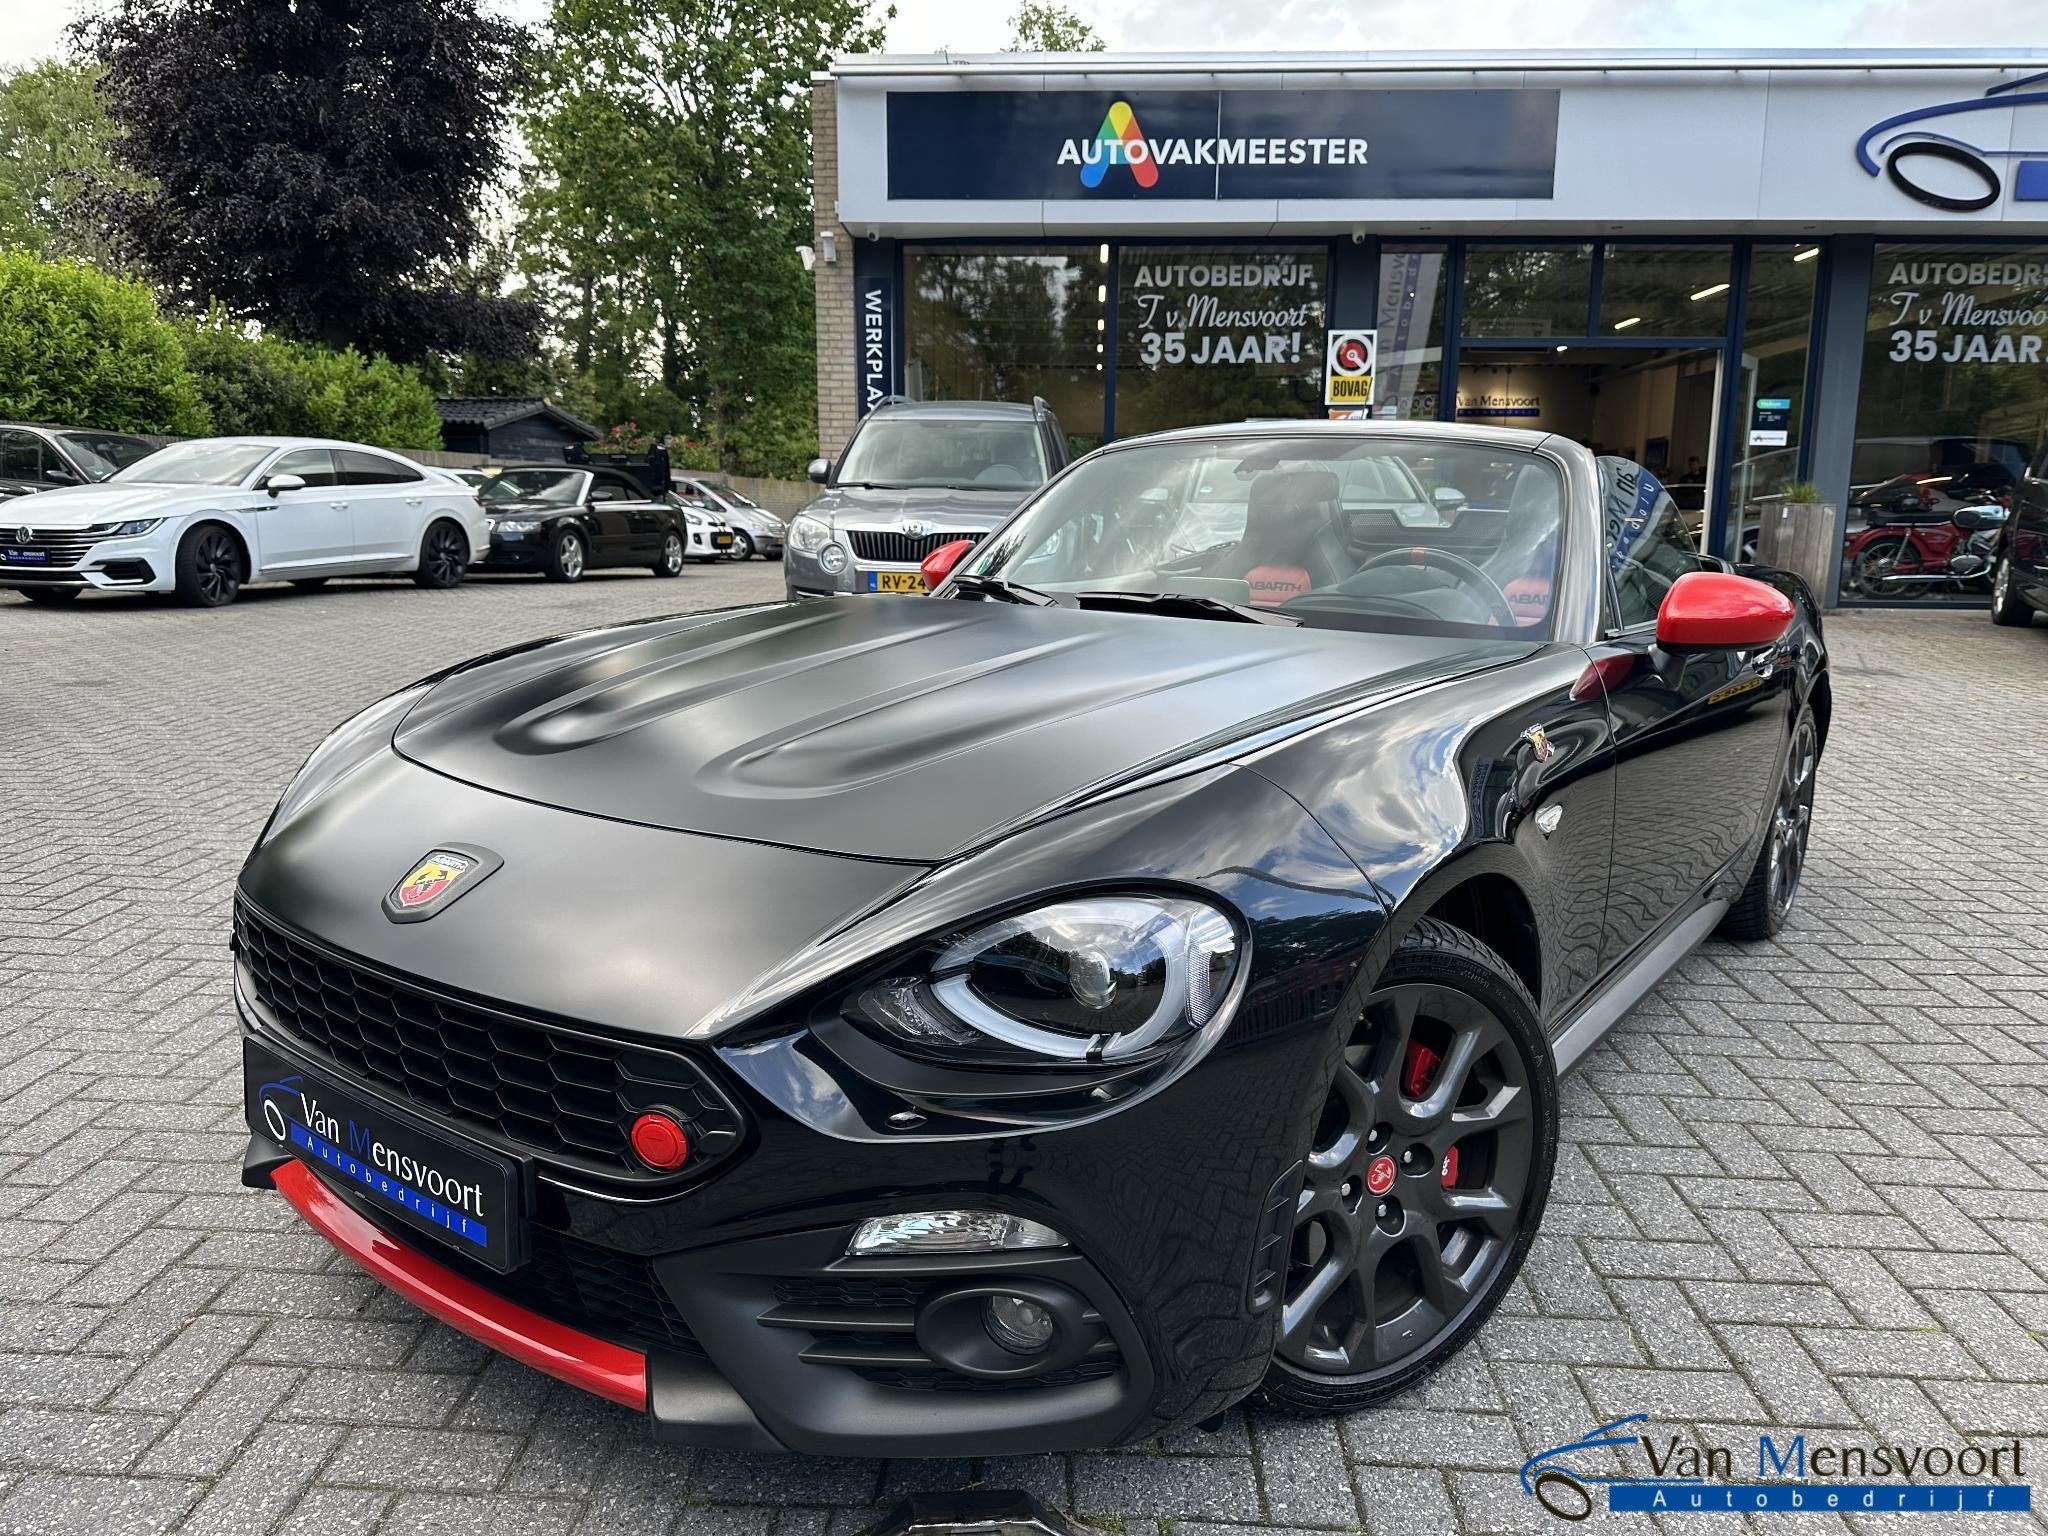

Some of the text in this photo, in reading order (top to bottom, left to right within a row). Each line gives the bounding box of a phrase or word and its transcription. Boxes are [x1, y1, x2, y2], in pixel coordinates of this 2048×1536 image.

[1057, 138, 1368, 165] AUTOVAKMEESTER
[1134, 265, 1313, 287] AUTOBEDRIJF
[1137, 294, 1165, 328] T
[1187, 293, 1309, 328] Mensvoort
[1889, 291, 1920, 326] T
[1140, 331, 1301, 365] 35 JAAR!
[1889, 329, 2048, 364] 35 JAAR
[1332, 380, 1368, 398] BOVAG
[1480, 395, 1540, 407] Mensvoort
[301, 1092, 485, 1218] Van Mensvoort
[306, 1135, 468, 1234] Autobedrijf
